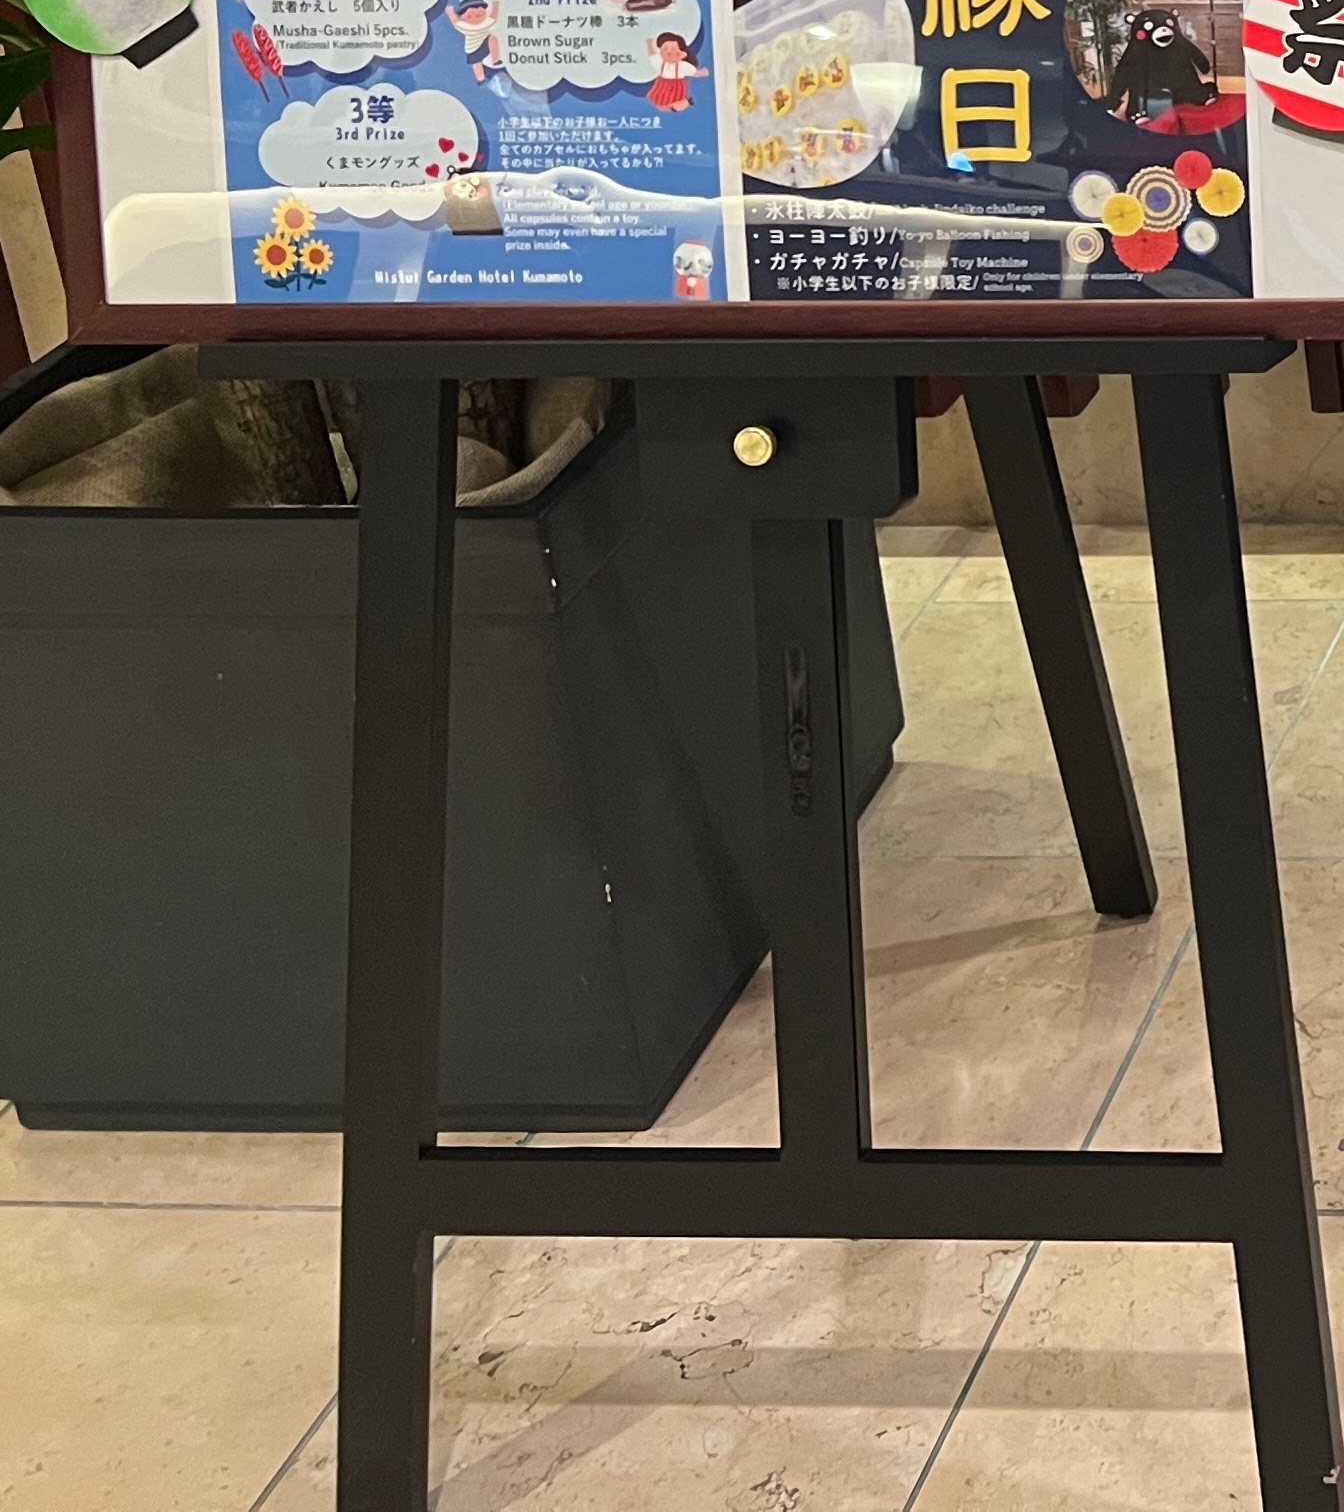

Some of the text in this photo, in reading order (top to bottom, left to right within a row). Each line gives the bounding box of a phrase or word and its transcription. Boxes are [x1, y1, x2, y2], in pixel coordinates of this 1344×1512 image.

[271, 0, 401, 14] 武者かえし 5個入り
[506, 15, 640, 30] 黒糖ドーナツ棒 3本
[272, 23, 410, 39] Musha-Gaeshi 5pcs.
[507, 34, 595, 50] Brown Sugar
[508, 51, 638, 67] Donut Stick 3pcs.
[349, 95, 396, 125] 3等
[335, 126, 406, 141] 3rd Prize
[325, 155, 422, 170] くまモングッズ
[951, 256, 975, 270] Toy
[976, 256, 1029, 268] Machine
[427, 270, 473, 284] Garden
[478, 270, 515, 283] Hotel
[523, 270, 583, 284] Kumamoto
